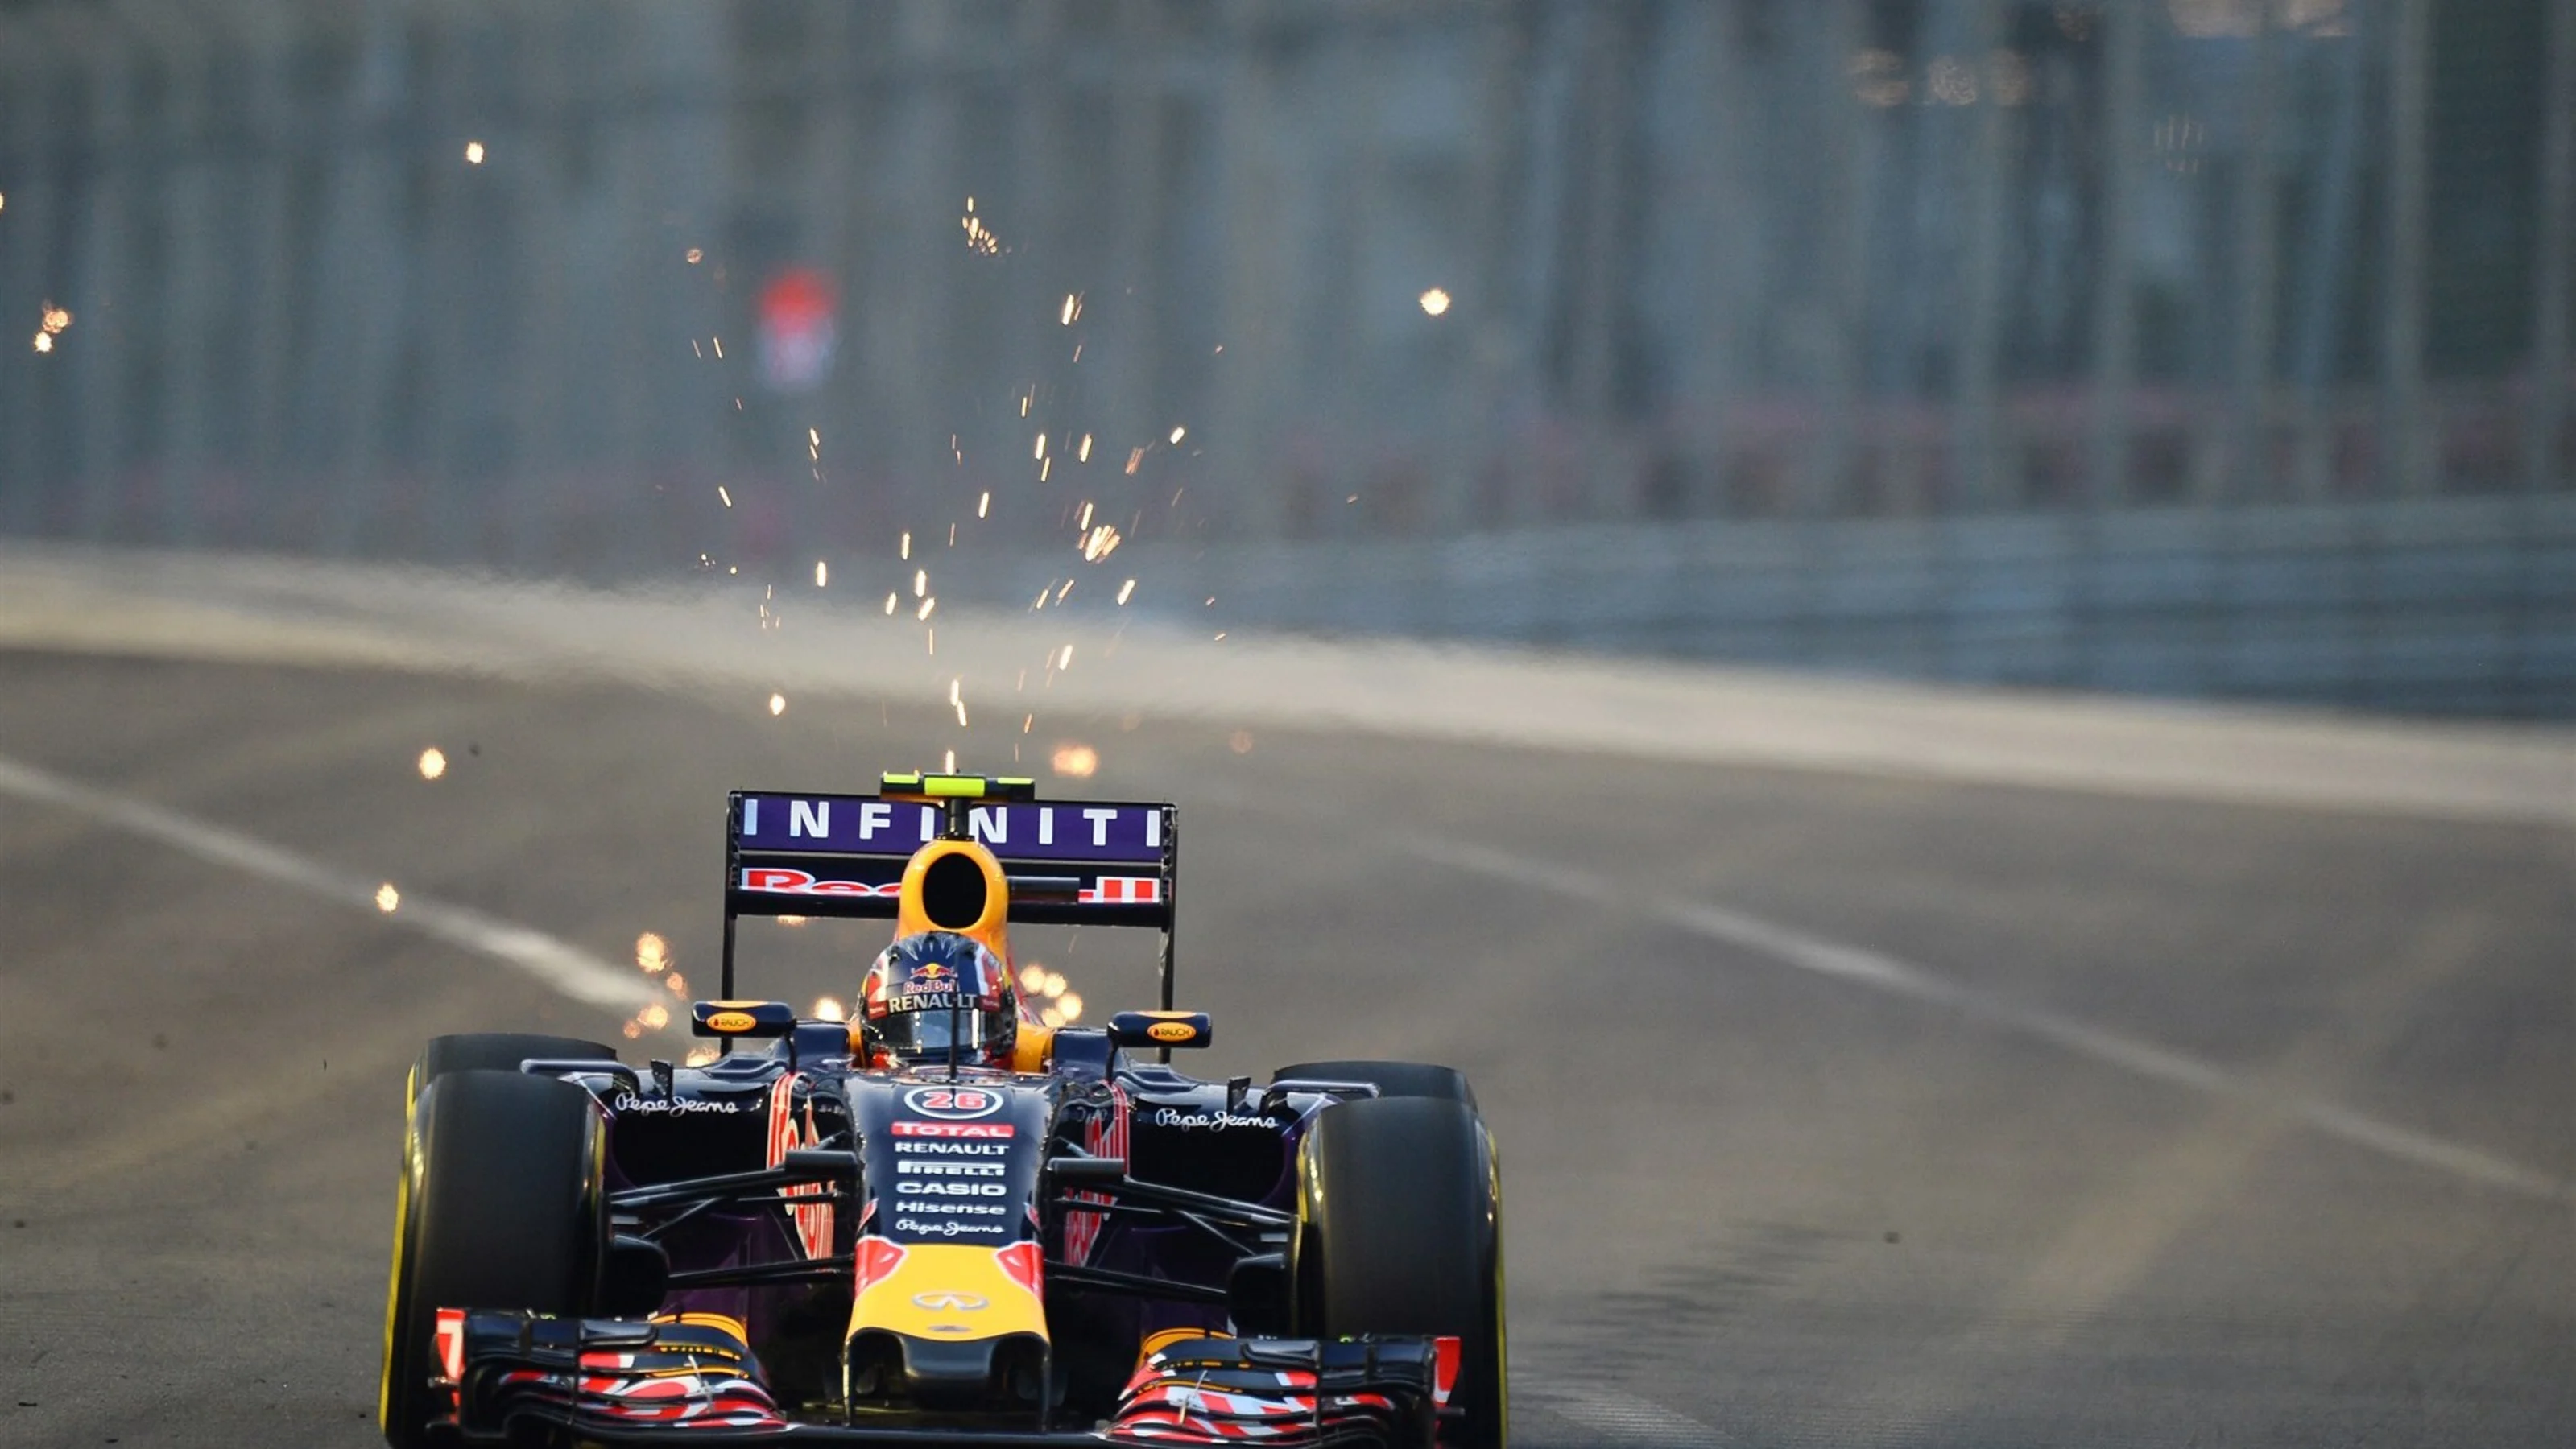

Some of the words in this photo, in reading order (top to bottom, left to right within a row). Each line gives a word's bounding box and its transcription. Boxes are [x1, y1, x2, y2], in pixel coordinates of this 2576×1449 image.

[743, 799, 1160, 847] INFINITI
[903, 979, 931, 995] Red
[721, 1018, 749, 1026] RAUCH
[1161, 1028, 1189, 1037] RAUCH
[615, 1092, 670, 1117] Pepe
[669, 1096, 739, 1117] Jeans
[922, 1092, 986, 1110] 26
[1156, 1108, 1209, 1133] Pepe
[1209, 1110, 1279, 1133] Jeans
[895, 1122, 1011, 1138] TOTAL
[895, 1141, 1010, 1155] RENAULT
[897, 1160, 1006, 1176] PIRELLI
[896, 1182, 1007, 1196] CASIO
[895, 1201, 1007, 1215] Hisense
[895, 1218, 944, 1236] Pepe
[943, 1220, 1005, 1236] Jeans
